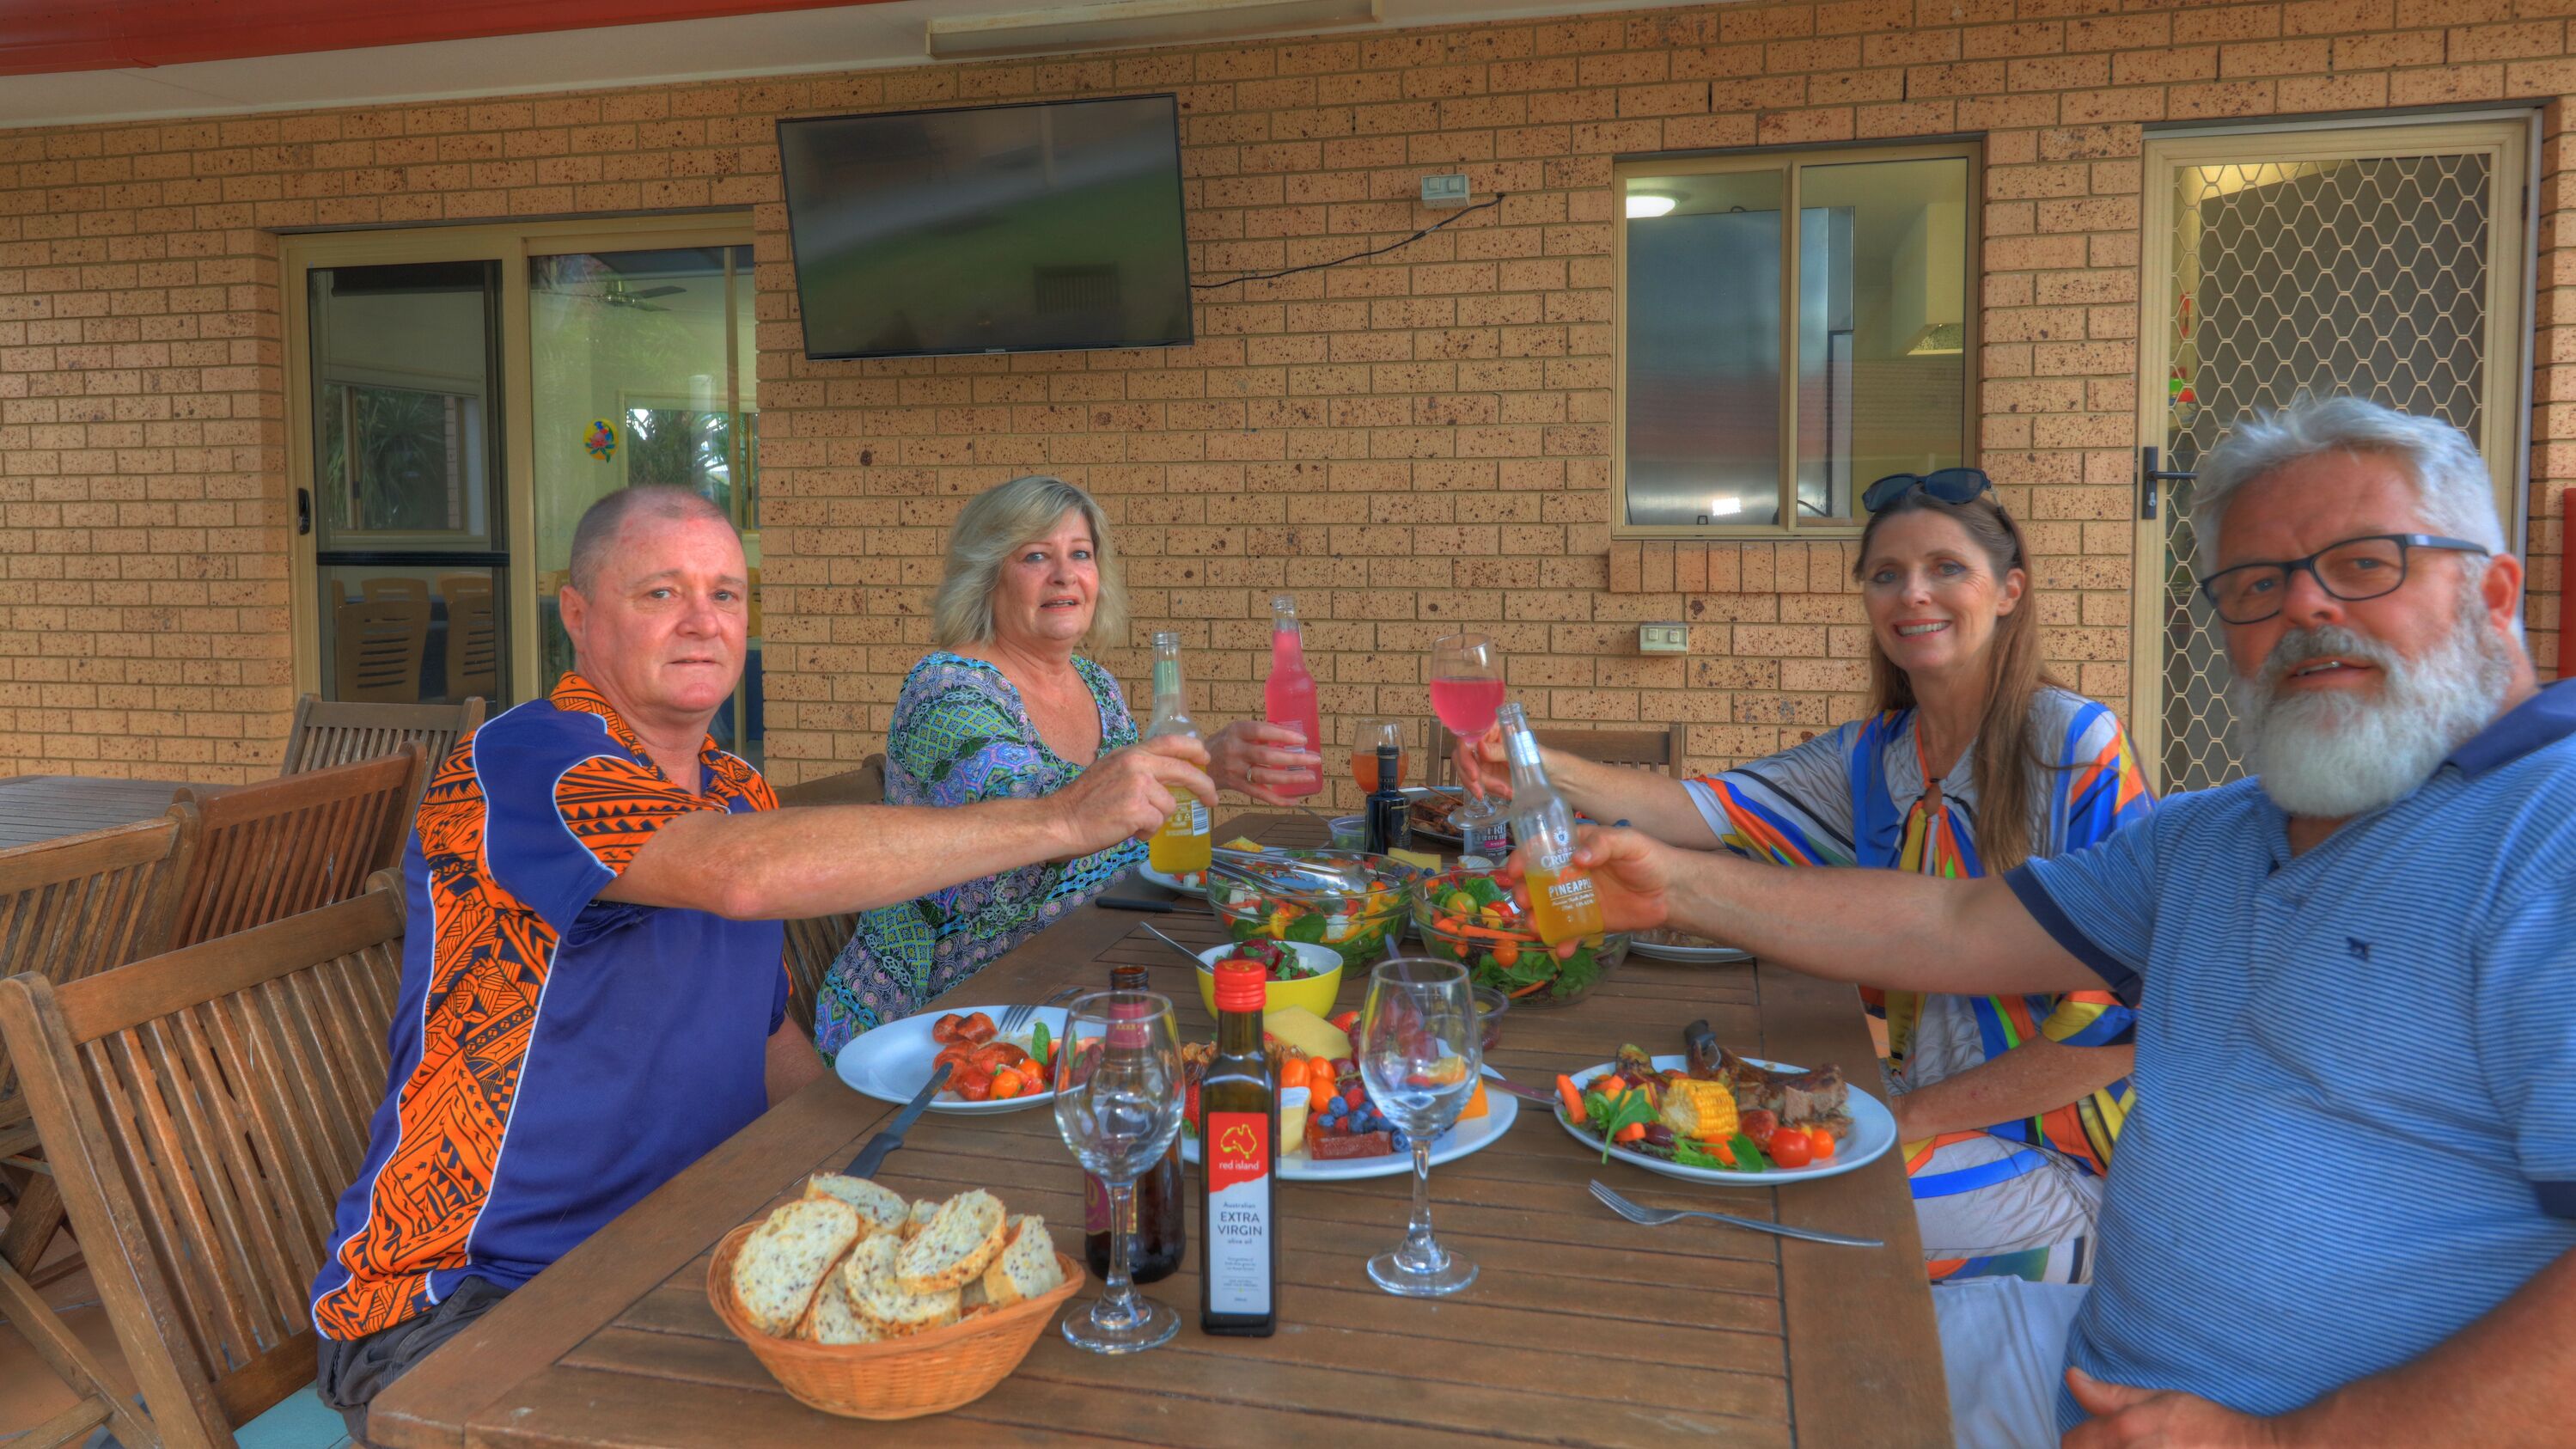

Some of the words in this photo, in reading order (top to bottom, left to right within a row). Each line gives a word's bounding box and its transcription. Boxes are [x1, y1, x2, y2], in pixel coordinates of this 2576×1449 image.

[1548, 877, 1592, 898] PINEAPPL
[1218, 1160, 1234, 1170] red
[1235, 1160, 1260, 1170] island
[1220, 1211, 1261, 1223] EXTRA
[1217, 1224, 1262, 1236] VIRGIN
